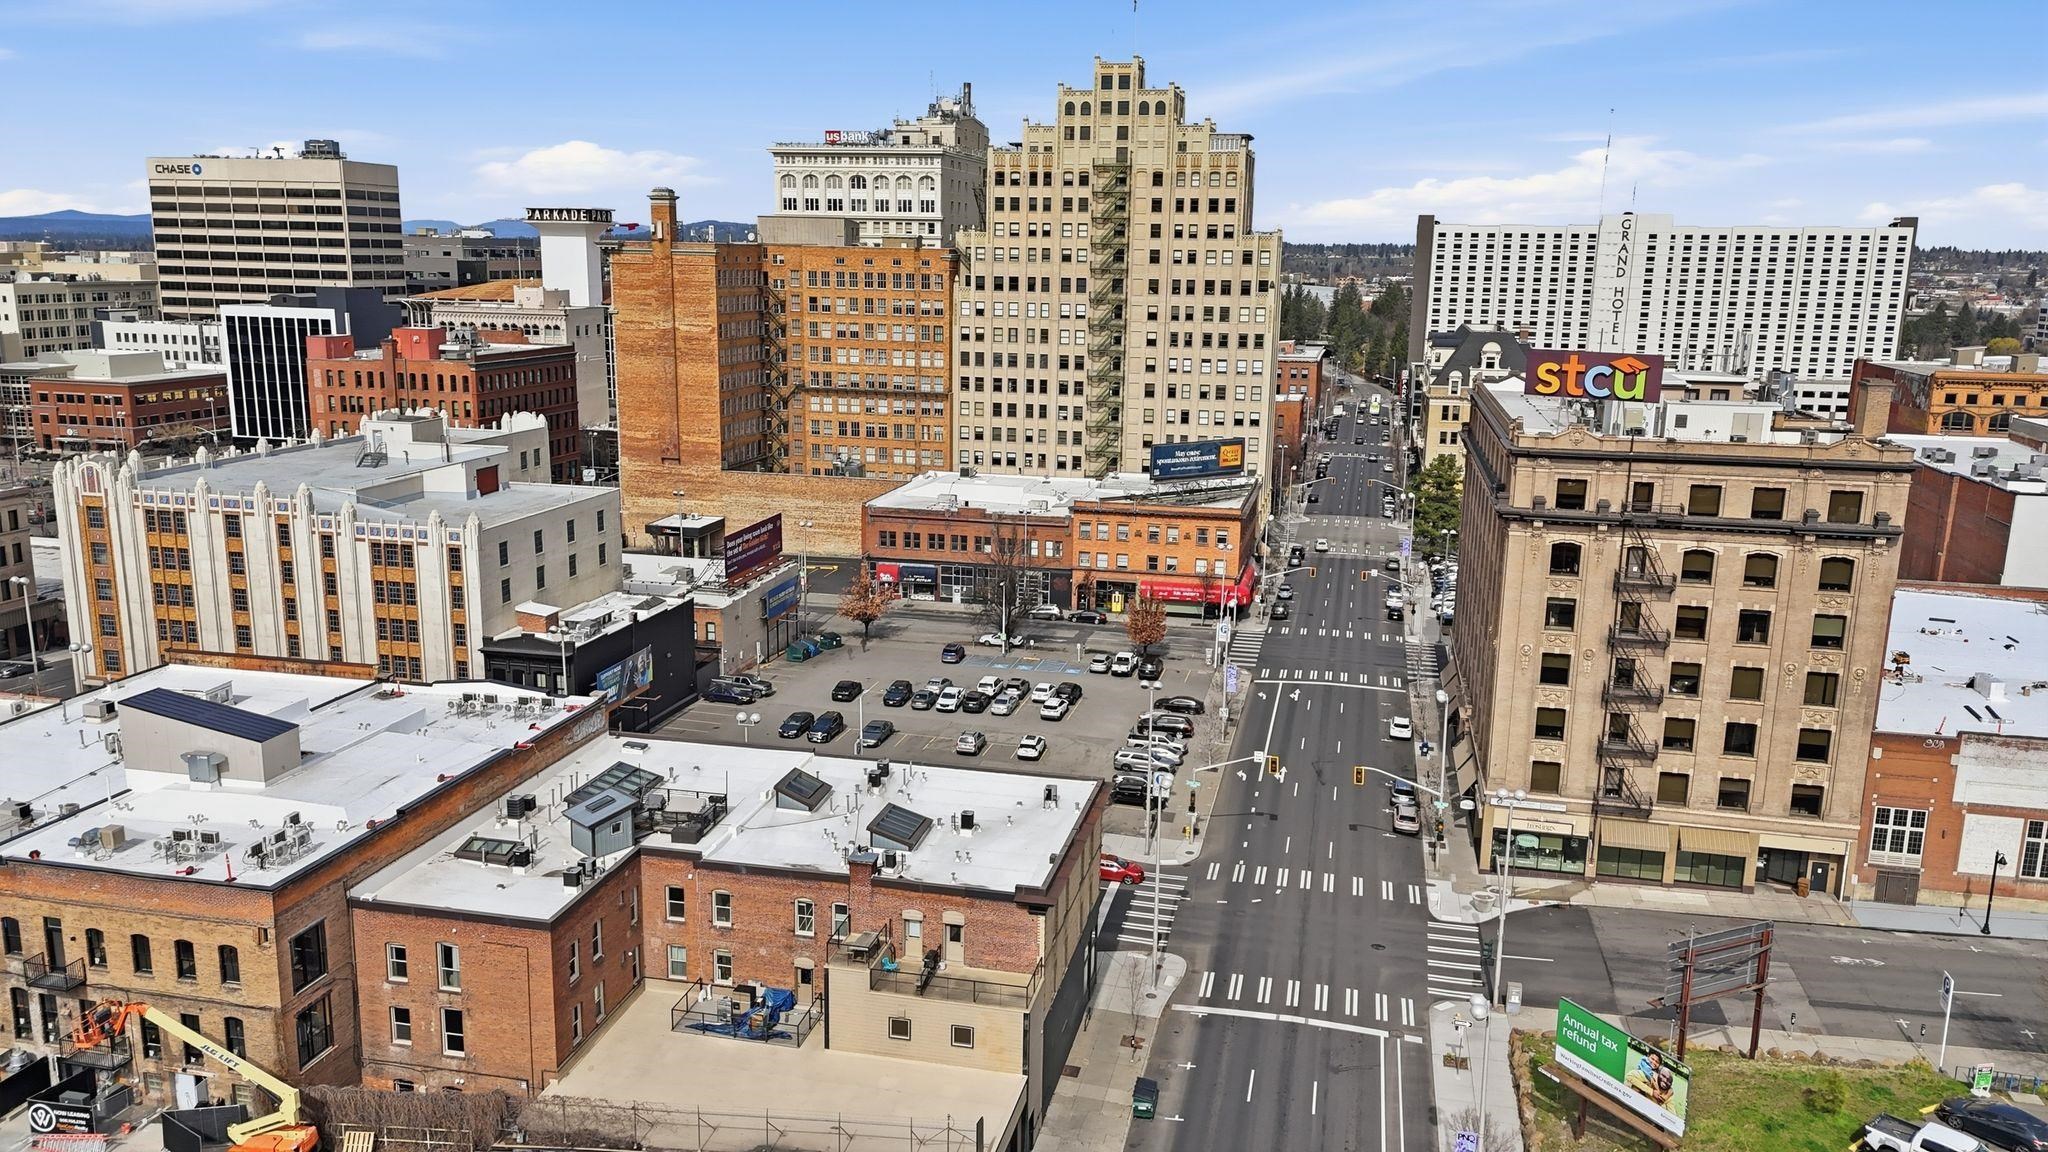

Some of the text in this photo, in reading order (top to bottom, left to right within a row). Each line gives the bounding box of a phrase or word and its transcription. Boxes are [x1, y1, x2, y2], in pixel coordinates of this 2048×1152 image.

[155, 164, 191, 174] CHASE
[525, 209, 587, 221] PARKADE
[1611, 218, 1632, 345] GRAND HOTEL
[1534, 354, 1648, 400] stcu
[1562, 1013, 1618, 1052] Annual tax
[1562, 1026, 1597, 1053] refund
[200, 1044, 240, 1068] JLG LIFT
[53, 1109, 90, 1119] NOW LEASING
